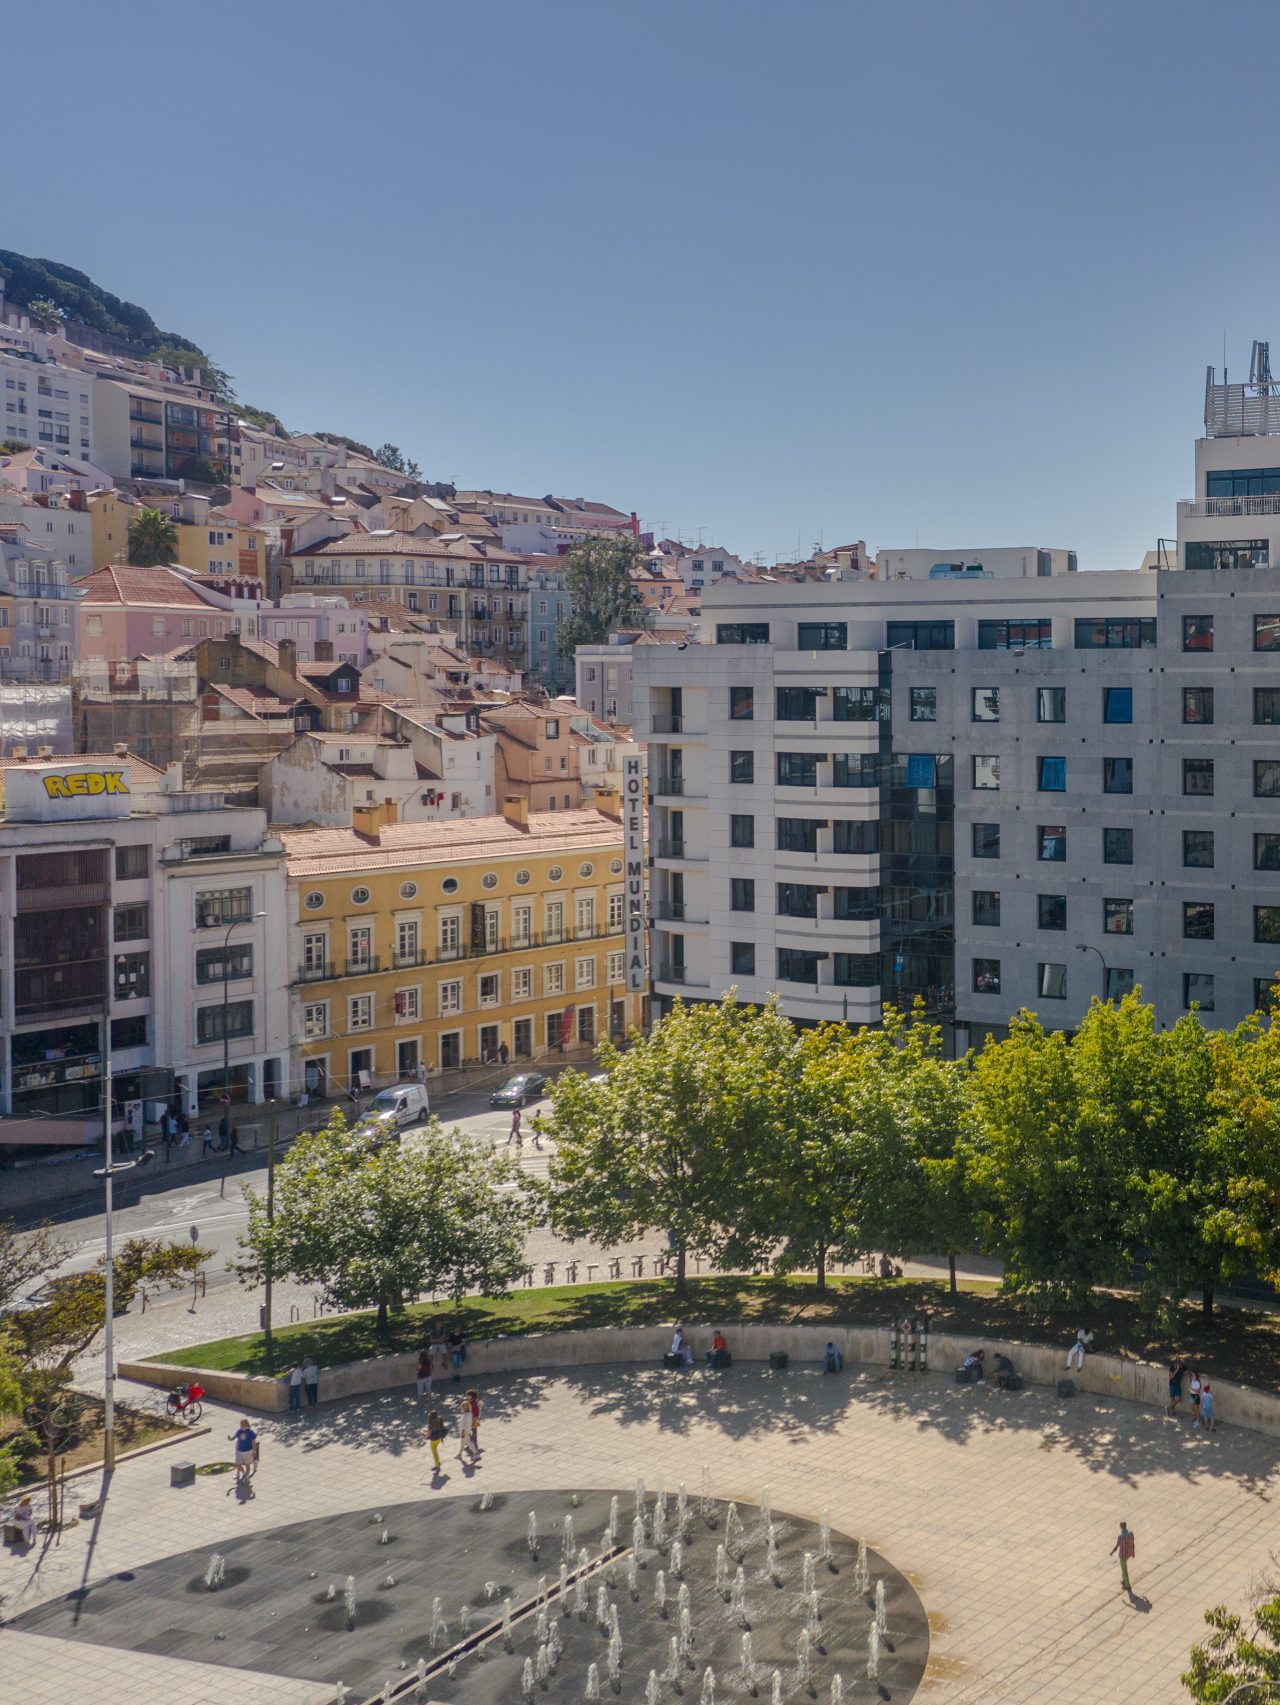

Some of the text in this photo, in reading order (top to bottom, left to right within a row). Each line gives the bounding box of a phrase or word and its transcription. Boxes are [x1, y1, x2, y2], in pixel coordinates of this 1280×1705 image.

[43, 771, 130, 799] REDK
[627, 760, 642, 988] HOTEL MUNDIAL
